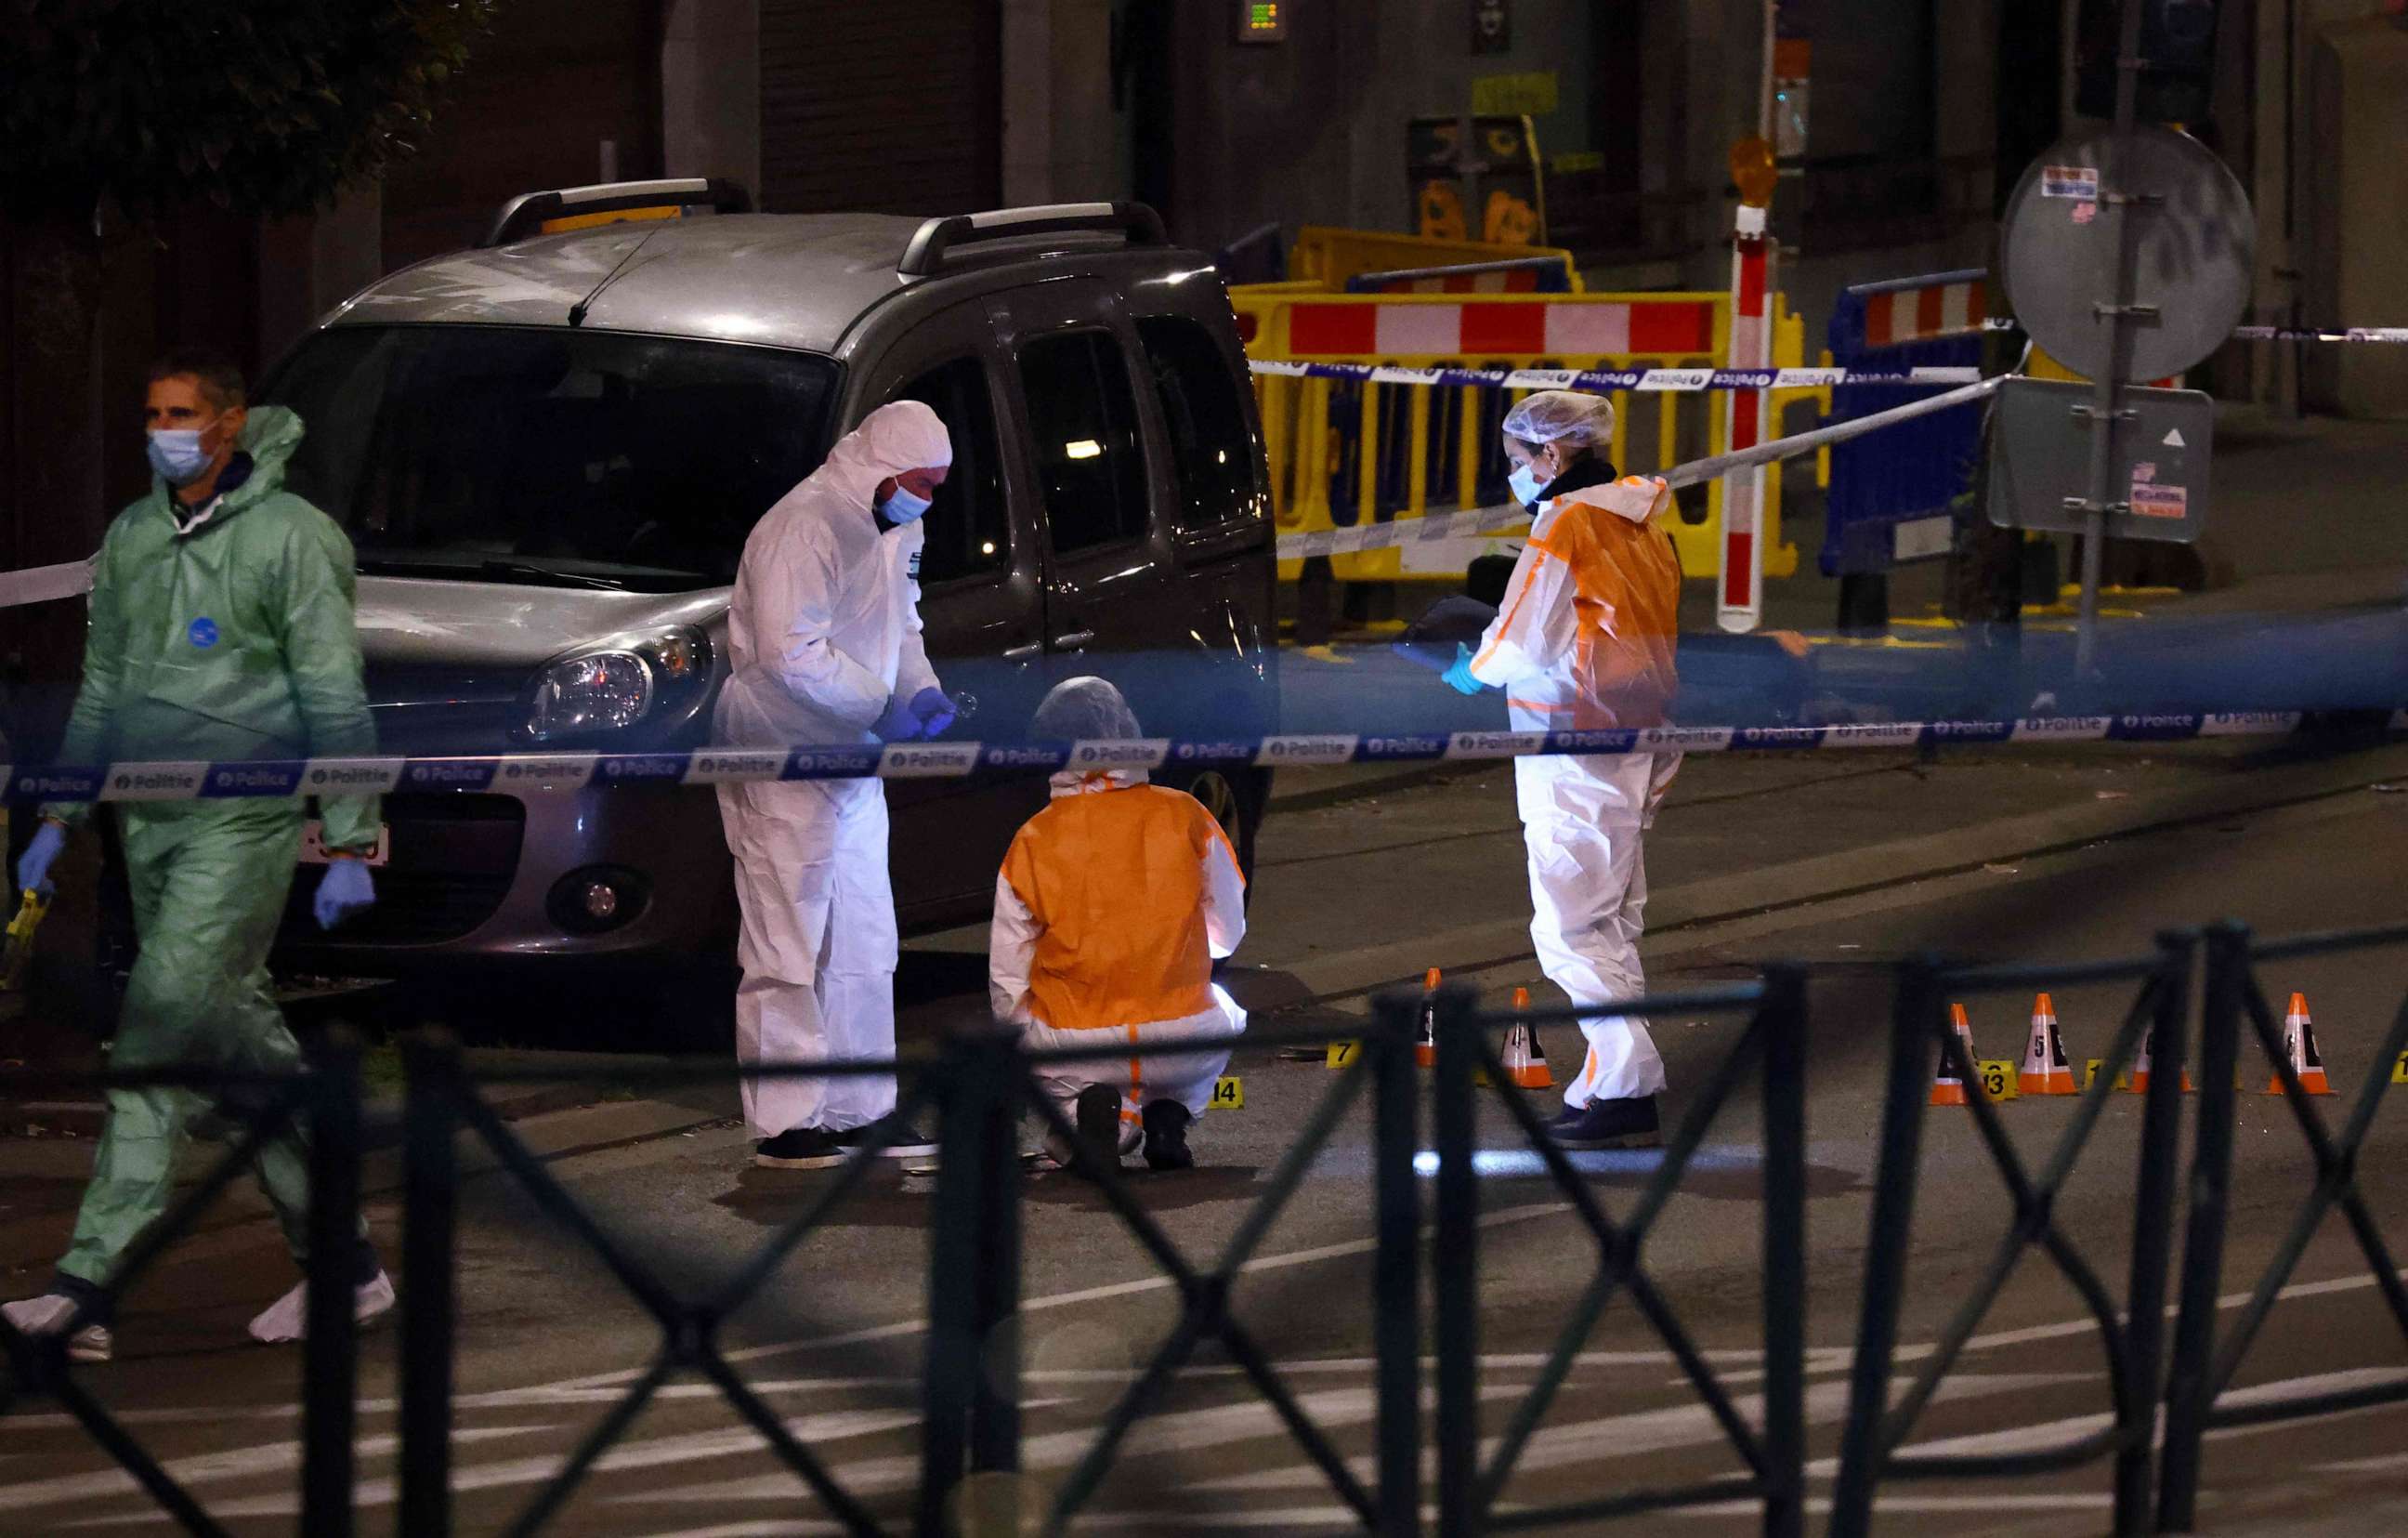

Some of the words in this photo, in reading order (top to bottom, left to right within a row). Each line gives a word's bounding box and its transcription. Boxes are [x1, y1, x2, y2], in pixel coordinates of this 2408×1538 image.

[1580, 372, 1624, 385] Police
[1647, 373, 1690, 386] Politie
[1712, 373, 1758, 386] Police
[134, 773, 194, 789] Politie
[234, 771, 288, 787] Police
[331, 769, 388, 783] Politie
[431, 766, 484, 782] Police
[624, 760, 677, 776] Police
[717, 757, 775, 773] Politie
[818, 755, 870, 770] Police
[906, 751, 966, 767] Politie
[1007, 748, 1059, 764] Police
[1099, 745, 1157, 761] Politie
[1197, 743, 1250, 758] Police
[1289, 739, 1345, 756] Politie
[1386, 736, 1439, 753] Police
[1477, 734, 1535, 750] Politie
[1576, 731, 1629, 747] Police
[1667, 728, 1723, 743] Politie
[1951, 720, 2004, 734] Police
[2142, 714, 2193, 728] Police
[1337, 1042, 1352, 1062] 7
[2035, 1035, 2045, 1058] 5
[1213, 1082, 1236, 1102] 14
[1984, 1074, 2004, 1095] 13
